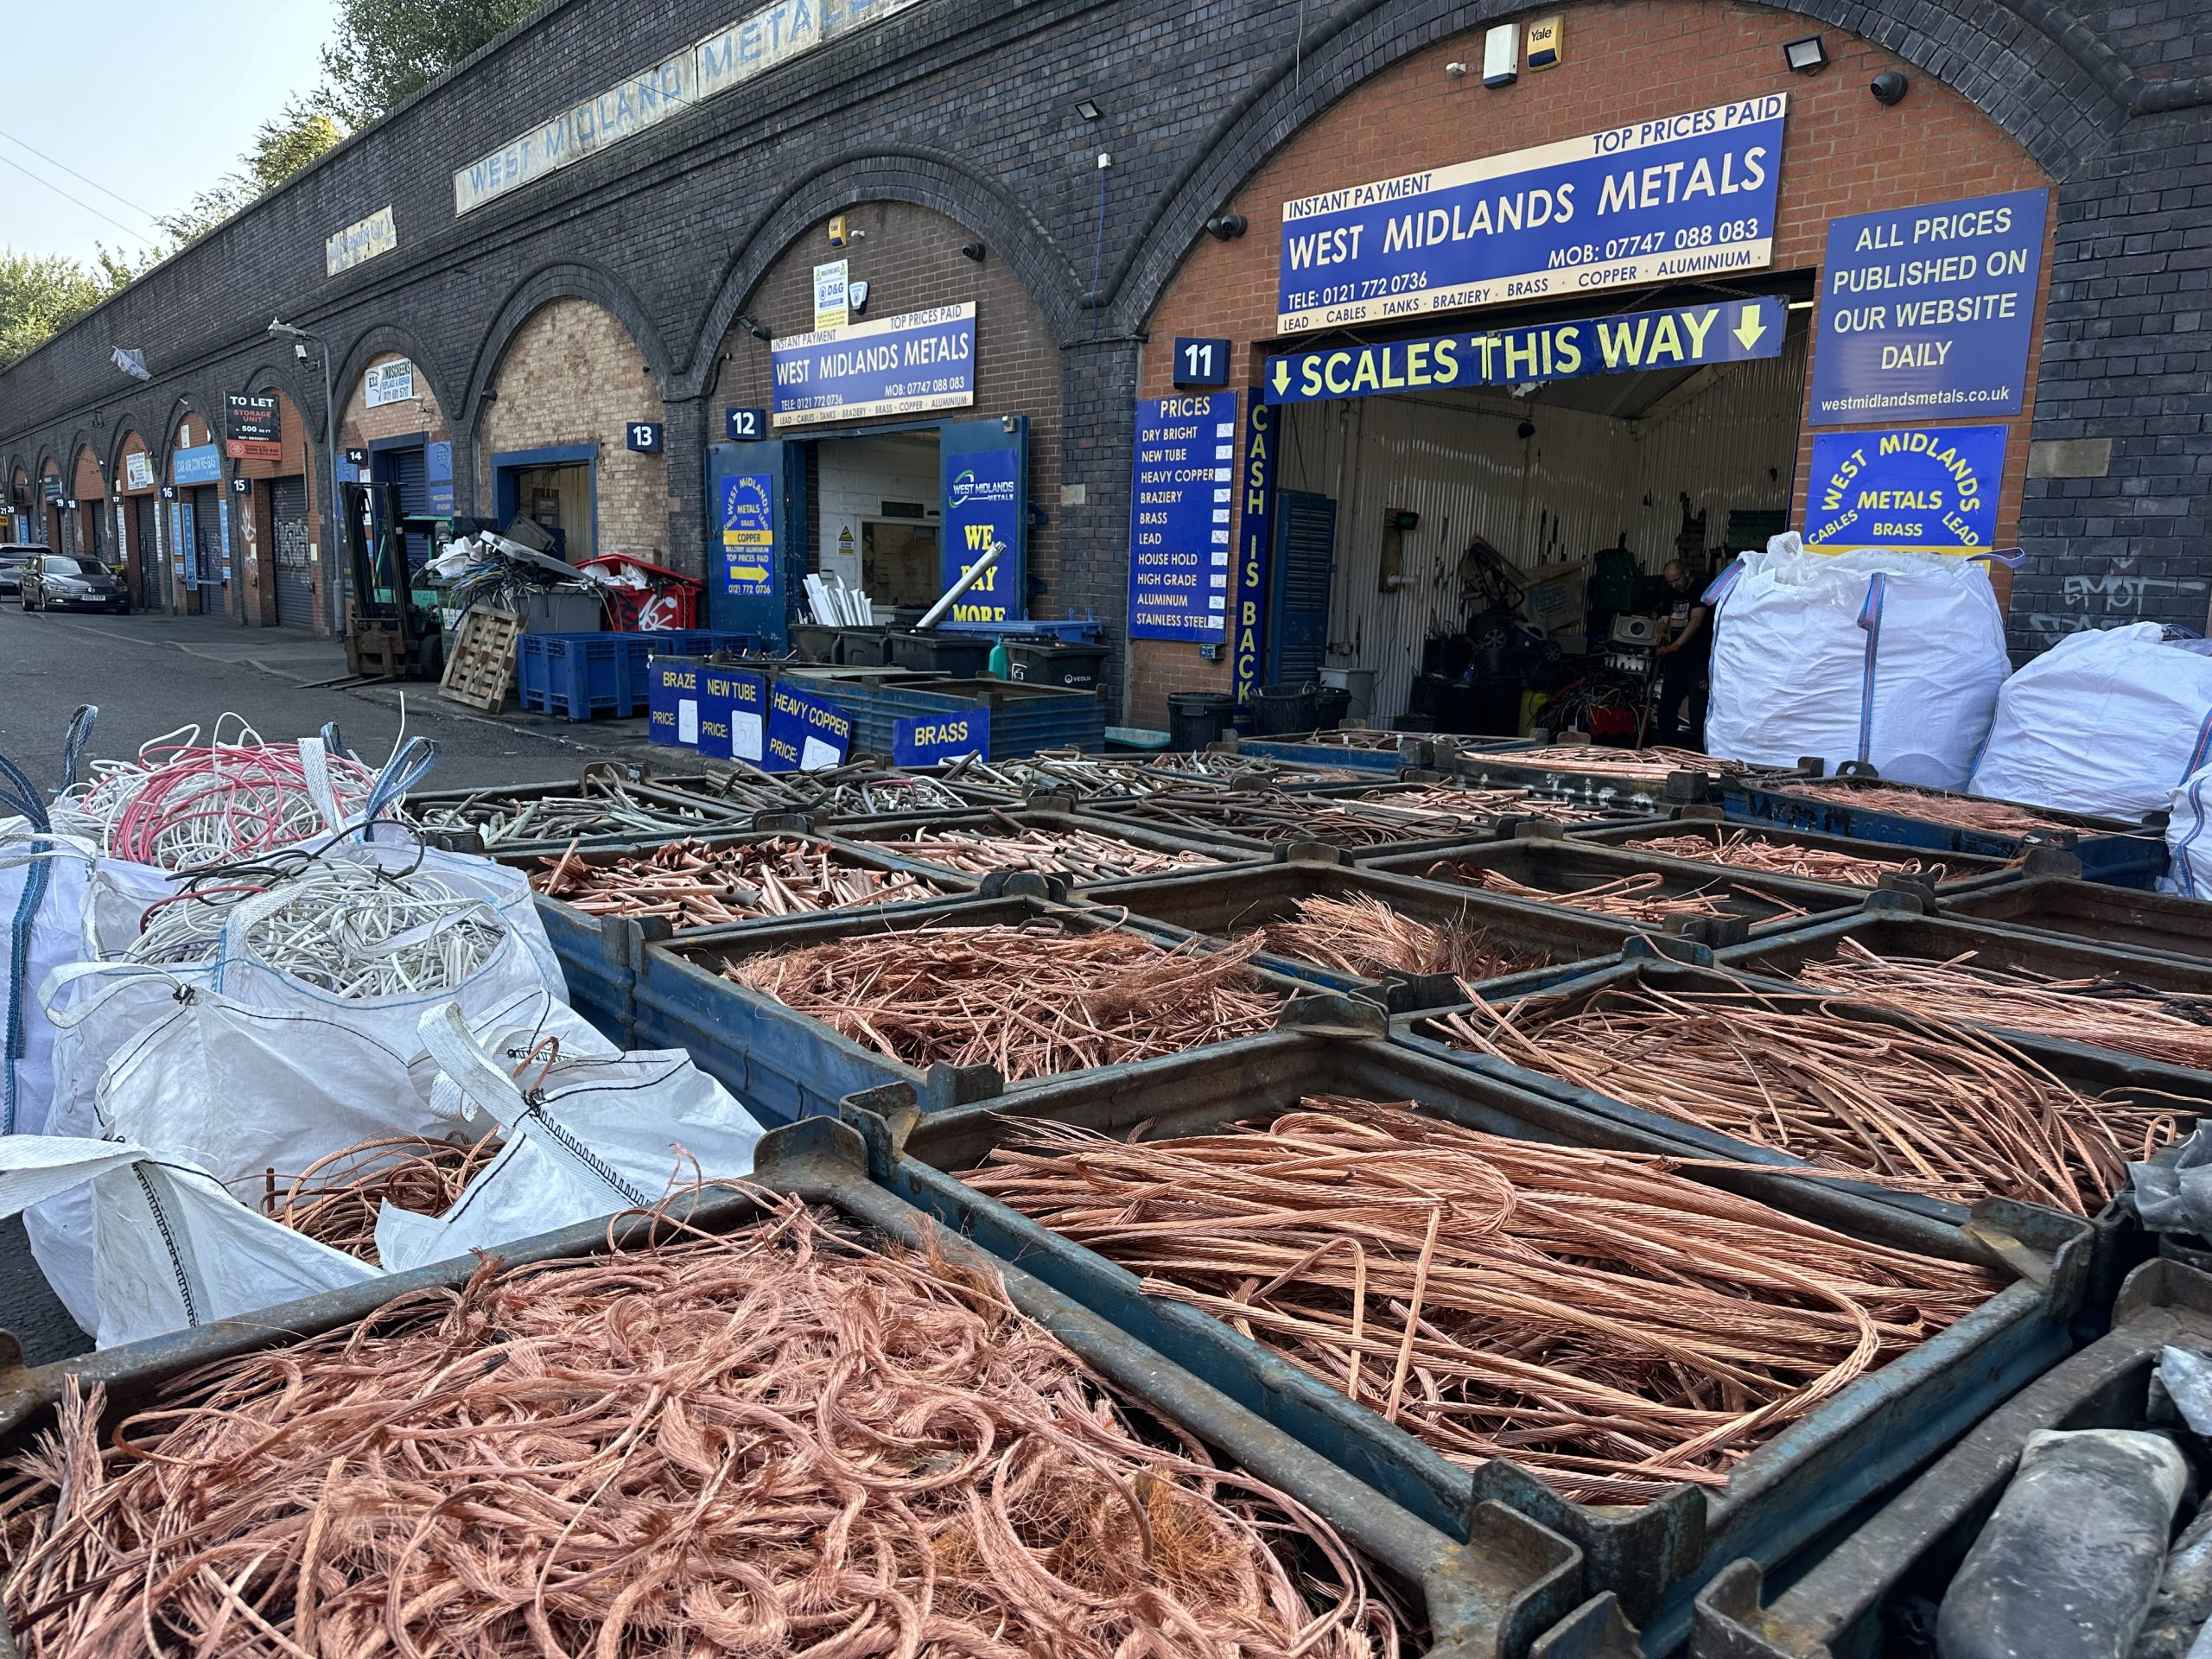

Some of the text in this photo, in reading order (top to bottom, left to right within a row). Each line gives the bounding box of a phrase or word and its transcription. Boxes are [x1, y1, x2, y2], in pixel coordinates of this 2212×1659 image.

[1531, 27, 1552, 42] Yale
[1593, 95, 1782, 154] TOP PRICES PAID
[469, 141, 531, 195] WEST
[1288, 173, 1432, 219] INSTANT PAYMENT
[1288, 146, 1767, 270] WEST MIDLANDS METALS
[1854, 207, 2012, 252] ALL PRICES
[1548, 218, 1758, 269] MOB: 07747 088 083
[1833, 248, 2028, 295] PUBLISHED ON
[828, 283, 843, 296] D&G
[1283, 251, 1751, 331] LEAD CABLES TANKS BRAZIERY BRASS COPPER ALUMINIUM
[1287, 270, 1427, 310] TELE: 0121 772 0736
[891, 304, 962, 330] TOP PRICES PAID
[1834, 292, 2018, 334] OUR WEBSITE
[773, 329, 836, 351] INSTANT PAYMENT
[776, 332, 969, 386] WEST MIDLANDS METALS
[1185, 344, 1212, 378] 11
[1300, 309, 1719, 397] SCALES THIS WAY
[1881, 340, 1953, 371] DAILY
[885, 376, 964, 397] MOB: 07747 088 083
[229, 396, 274, 407] TO LET
[781, 394, 842, 411] TELE: 0121 772 0736
[1160, 396, 1210, 419] PRICES
[1821, 385, 2010, 412] westmidlandsmetals.co.uk
[233, 409, 272, 417] STORAGE
[779, 396, 967, 424] LEAD CABLES TANKS BRAZIERY BRASS COPPER ALUMINIUM
[732, 411, 755, 435] 12
[632, 425, 652, 446] 13
[1142, 426, 1198, 442] DRY BRIGHT
[350, 451, 362, 461] 14
[1141, 448, 1186, 463] NEW TUBE
[1247, 404, 1268, 515] CASH
[1141, 468, 1214, 483] HEAVY COPPER
[1821, 432, 1980, 512] WEST MIDLANDS
[162, 487, 173, 498] 16
[233, 480, 245, 492] 15
[728, 477, 769, 515] WEST MIDLANDS
[953, 481, 1014, 495] WEST MIDLANDS
[56, 499, 64, 507] 19
[67, 500, 75, 509] 18
[1141, 491, 1182, 504] BRAZIERY
[1857, 490, 1942, 510] METALS
[737, 504, 760, 514] METALS
[1140, 512, 1167, 524] BRASS
[723, 514, 738, 531] CABLES
[759, 513, 769, 531] LEAD
[1808, 509, 1979, 546] CABLES BRASS LEAD
[737, 533, 760, 543] COPPER
[964, 524, 994, 551] WE
[1139, 533, 1161, 544] LEAD
[738, 554, 755, 563] PRICES
[1138, 553, 1198, 565] HOUSE HOLD
[1244, 535, 1259, 588] IS
[728, 584, 771, 594] 0121 772 0736
[1137, 573, 1197, 587] HIGH GRADE
[1137, 593, 1188, 607] ALUMINUM
[1136, 613, 1208, 628] STAINLESS STEEL
[1237, 601, 1256, 705] BACK
[707, 678, 756, 702] NEW TUBE
[652, 711, 676, 726] PRICE:
[774, 692, 849, 738] HEAVY COPPER
[702, 721, 728, 738] PRICE:
[914, 721, 968, 747] BRASS
[770, 738, 798, 763] PRICE:
